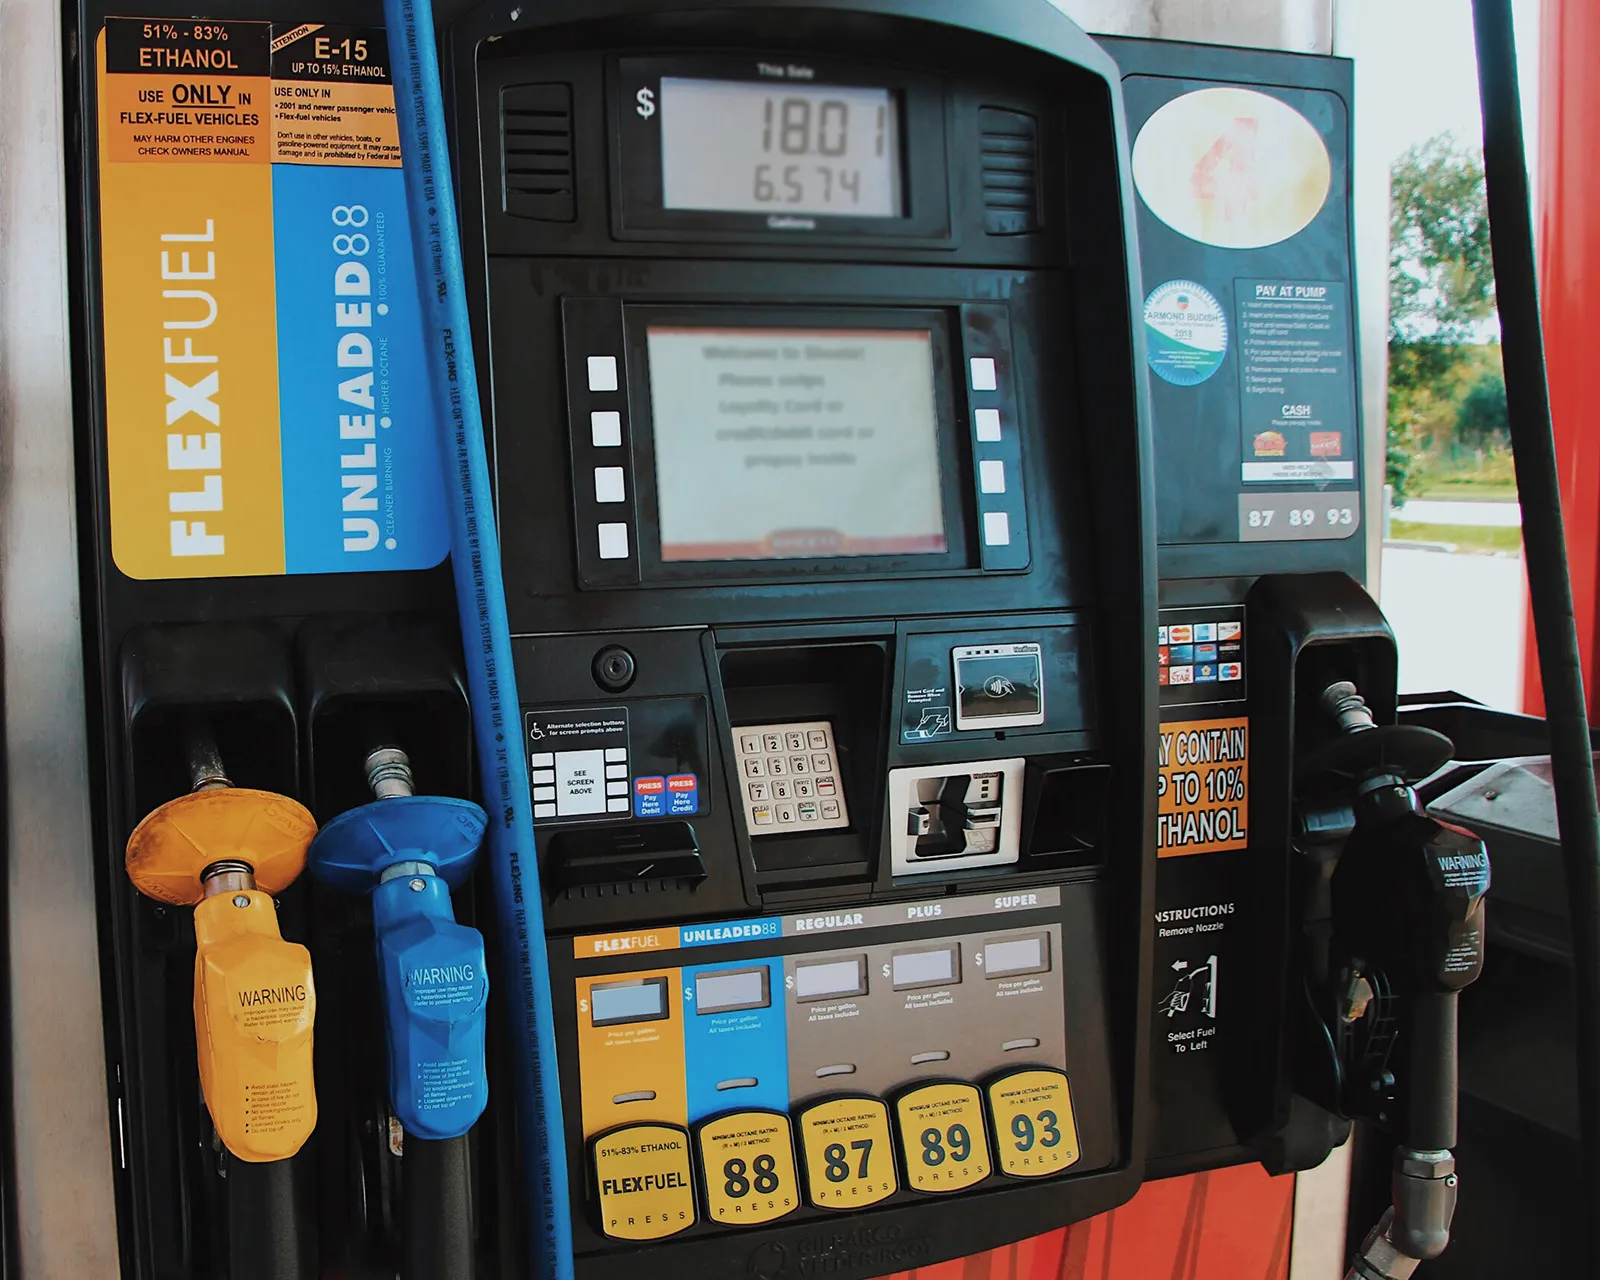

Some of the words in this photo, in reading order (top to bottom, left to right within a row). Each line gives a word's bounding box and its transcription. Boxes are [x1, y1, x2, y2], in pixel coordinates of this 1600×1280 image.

[143, 24, 178, 40] 51%
[194, 25, 228, 41] 83%
[271, 26, 309, 51] ATTENTION
[315, 37, 368, 61] E-15
[139, 47, 238, 69] ETHANOL
[292, 62, 305, 73] UP
[307, 62, 320, 74] TO
[322, 63, 340, 75] 15%
[342, 65, 386, 77] ETHANOL
[138, 90, 164, 103] USE
[172, 83, 232, 105] ONLY
[238, 93, 252, 105] IN
[274, 87, 293, 97] USE
[295, 88, 319, 98] ONLY
[321, 89, 331, 98] IN
[279, 102, 296, 110] 2001
[336, 105, 374, 114] passenger
[375, 106, 396, 114] vehic
[636, 87, 655, 119] $
[120, 112, 192, 125] FLEX-FUEL
[195, 113, 259, 126] VEHICLES
[279, 112, 310, 120] Flex-fuel
[311, 114, 341, 122] vehicles
[133, 135, 153, 143] MAY
[154, 135, 181, 143] HARM
[182, 135, 214, 144] OTHER
[216, 136, 255, 144] ENGINES
[277, 141, 329, 149] gasoline-powered
[138, 147, 170, 155] CHECK
[171, 147, 212, 156] OWNERS
[213, 148, 250, 156] MANUAL
[278, 149, 302, 157] damage
[324, 151, 356, 159] prohibited
[358, 152, 365, 160] by
[366, 152, 389, 160] Federal
[376, 212, 387, 275] GUARANTEED
[1255, 284, 1276, 297] PAY
[1279, 285, 1293, 298] AT
[1296, 286, 1326, 299] PUMP
[380, 337, 389, 377] OCTANE
[331, 204, 380, 552] UNLEADED88
[161, 219, 225, 557] FLEXFUEL
[381, 380, 390, 414] HIGHER
[1282, 405, 1311, 416] CASH
[384, 447, 393, 490] BURNING
[459, 460, 471, 494] PREMIUM
[386, 493, 395, 535] CLEANER
[463, 497, 475, 515] FUEL
[1248, 510, 1275, 527] 87
[1289, 509, 1315, 526] 89
[1327, 508, 1352, 525] 93
[467, 517, 478, 537] HOSE
[470, 539, 480, 548] BY
[472, 551, 484, 587] FRANKLIN
[476, 589, 488, 621] FUELING
[480, 623, 493, 655] SYSTEMS
[749, 743, 754, 751] 1
[771, 742, 777, 750] 2
[793, 740, 799, 748] 3
[1176, 726, 1245, 765] CONTAIN
[752, 766, 759, 774] 4
[775, 765, 781, 773] 5
[797, 763, 804, 771] 6
[638, 781, 662, 789] PRESS
[669, 780, 693, 788] PRESS
[801, 786, 808, 795] 9
[1171, 770, 1200, 806] TO
[1205, 766, 1245, 802] 10%
[756, 790, 762, 798] 7
[779, 788, 785, 797] 8
[671, 805, 693, 813] Credit
[673, 798, 690, 806] Here
[641, 807, 661, 815] Debit
[783, 811, 789, 820] 0
[1157, 807, 1245, 848] THANOL
[1438, 854, 1487, 870] WARNING
[1155, 903, 1235, 922] NSTRUCTIONS
[594, 934, 661, 953] FLEXFUEL
[683, 922, 777, 943] UNLEADED88
[795, 913, 864, 931] REGULAR
[907, 904, 942, 919] PLUS
[994, 894, 1037, 909] SUPER
[1159, 927, 1194, 937] Remove
[1196, 922, 1224, 932] Nozzle
[412, 964, 474, 986] WARNING
[238, 984, 306, 1008] WARNING
[929, 998, 953, 1006] included
[933, 991, 950, 999] gallon
[1168, 1030, 1194, 1042] Select
[1197, 1027, 1215, 1038] Fuel
[1175, 1044, 1186, 1053] To
[1191, 1041, 1207, 1050] Left
[1011, 1109, 1062, 1152] 93
[601, 1144, 640, 1157] 51%-83%
[641, 1141, 682, 1153] ETHANOL
[920, 1123, 971, 1167] 89
[823, 1138, 874, 1184] 87
[602, 1171, 688, 1196] FLEXFUEL
[723, 1153, 780, 1199] 88
